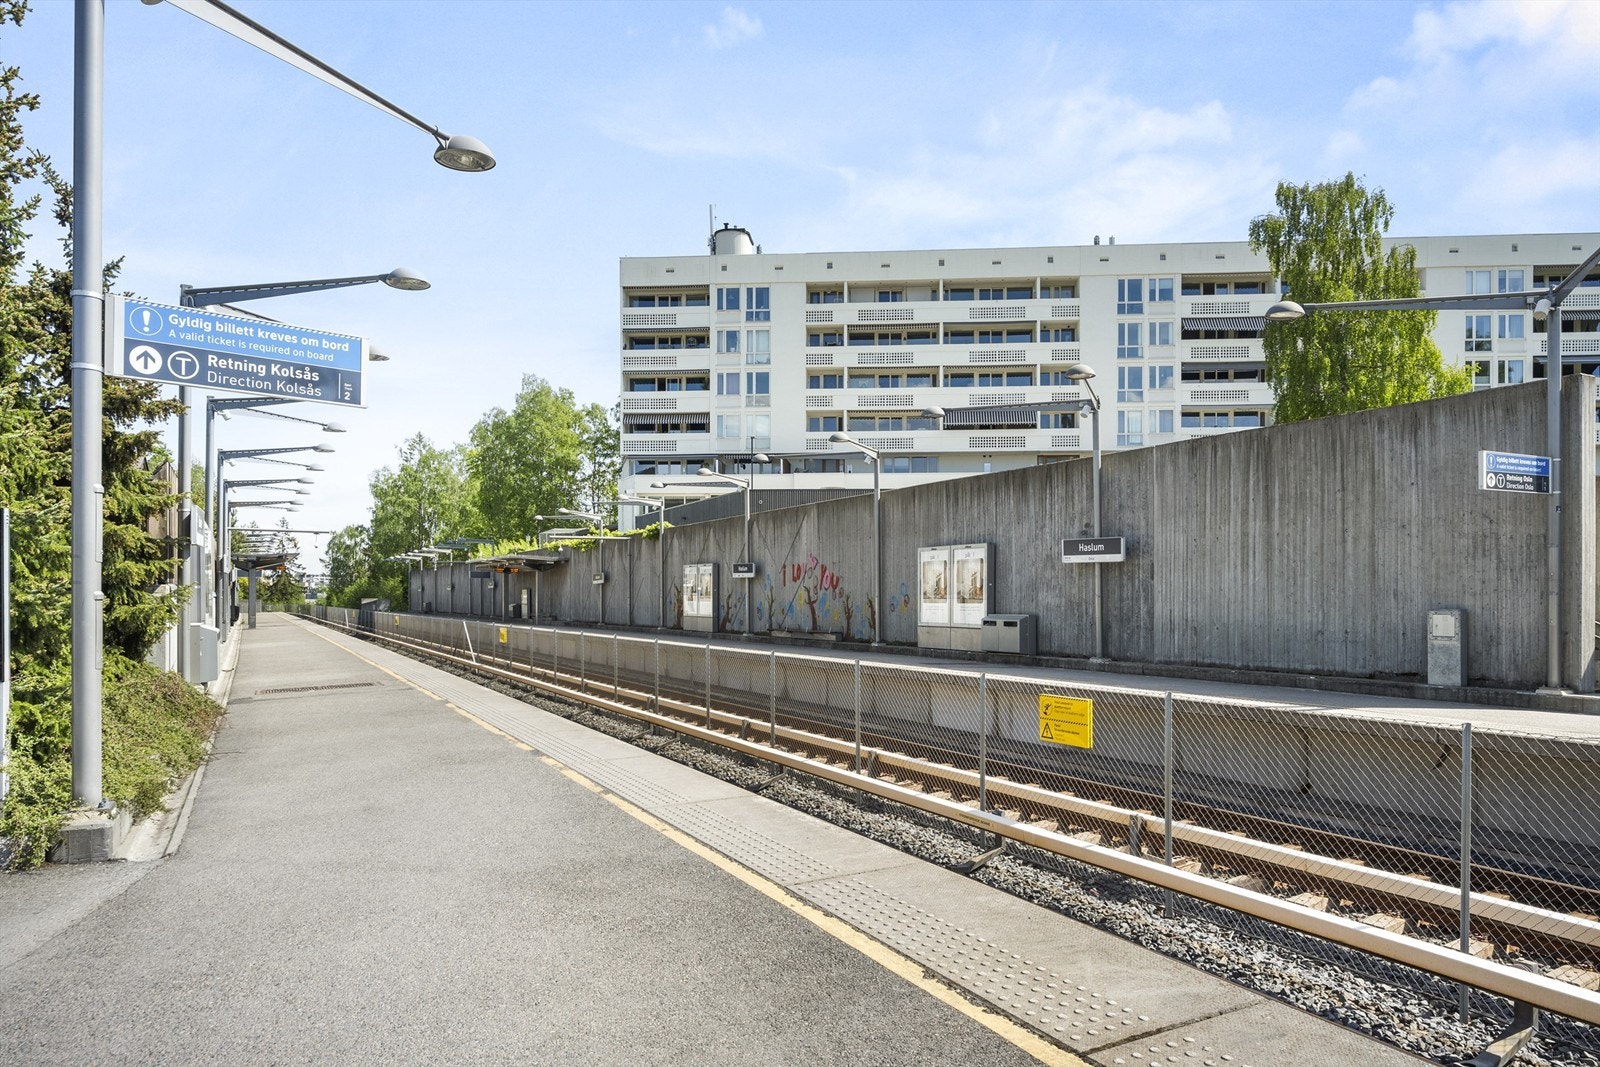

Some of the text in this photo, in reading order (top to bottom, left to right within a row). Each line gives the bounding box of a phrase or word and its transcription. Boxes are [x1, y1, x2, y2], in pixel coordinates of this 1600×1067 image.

[168, 314, 349, 352] Gyldig billett kreves om bord
[168, 329, 334, 361] A valid ticket is required on board
[176, 357, 191, 375] T
[207, 354, 320, 381] Retning Kolsås
[207, 371, 322, 396] Direction Kolsås
[344, 391, 351, 401] 2
[1496, 456, 1508, 464] Gyldig
[1506, 474, 1523, 483] Retning
[1078, 543, 1105, 552] Haslum
[820, 564, 840, 591] YOU
